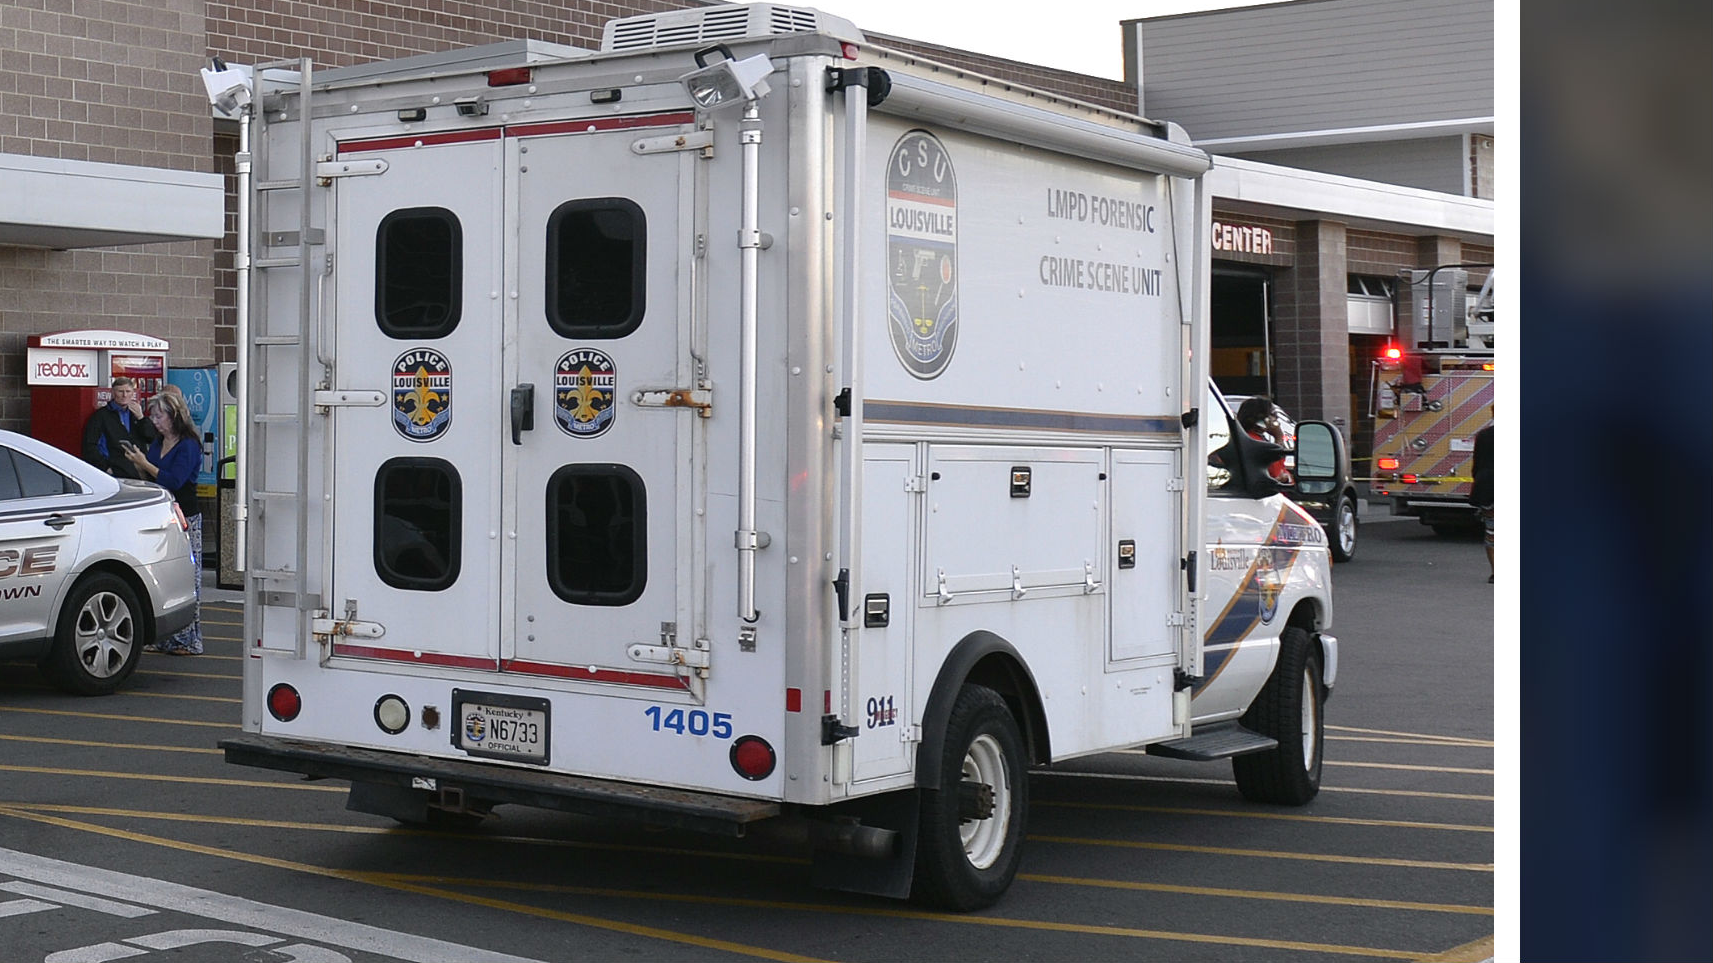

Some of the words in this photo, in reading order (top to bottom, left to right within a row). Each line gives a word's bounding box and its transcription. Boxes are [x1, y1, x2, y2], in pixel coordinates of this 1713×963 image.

[890, 205, 954, 236] LOUISVILLE
[1047, 188, 1087, 222] LMPD
[1091, 195, 1155, 234] FORENSIC
[1211, 221, 1273, 255] CENTER
[1039, 255, 1084, 290] CRIME
[1087, 261, 1129, 295] SCENE
[1132, 267, 1162, 297] UNIT
[61, 338, 91, 346] SMARTER
[911, 337, 936, 357] METRO
[398, 352, 446, 372] POLICE
[560, 352, 610, 371] POLICE
[394, 377, 450, 388] LOUISVILLE
[556, 376, 614, 386] LOUISVILLE
[485, 707, 524, 720] Kentucky
[866, 695, 896, 729] 911
[490, 718, 538, 744] N6733
[644, 705, 733, 740] 1405
[487, 741, 521, 752] OFFICIAL
